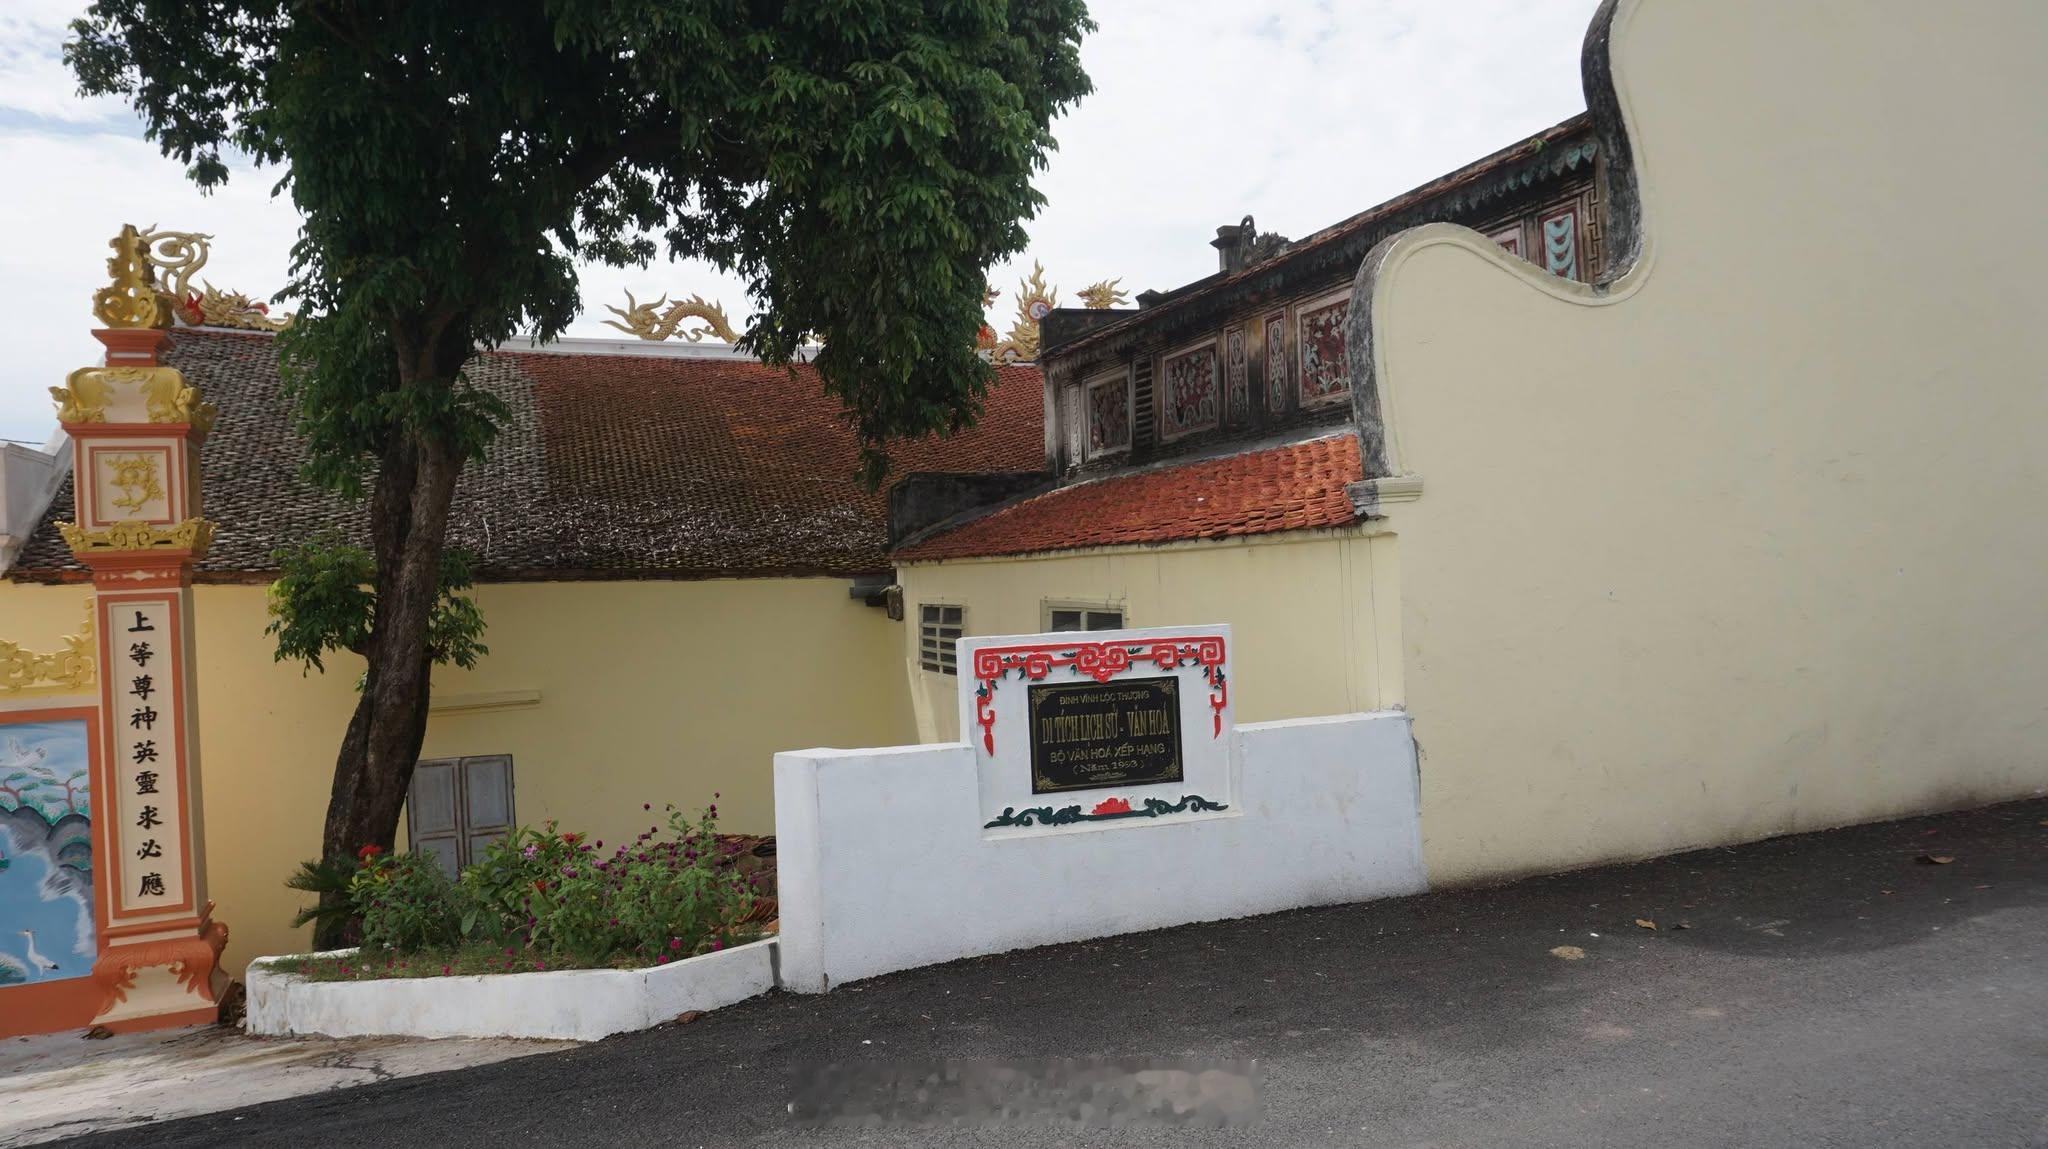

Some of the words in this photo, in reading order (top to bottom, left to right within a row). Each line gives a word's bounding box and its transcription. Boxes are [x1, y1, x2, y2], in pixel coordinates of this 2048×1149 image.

[127, 611, 165, 898] 上等尊神英靈求必應
[1050, 749, 1066, 765] BỘ
[1067, 747, 1089, 761] VĂN
[1114, 742, 1134, 758] XẾP
[1136, 742, 1166, 758] HẠNG
